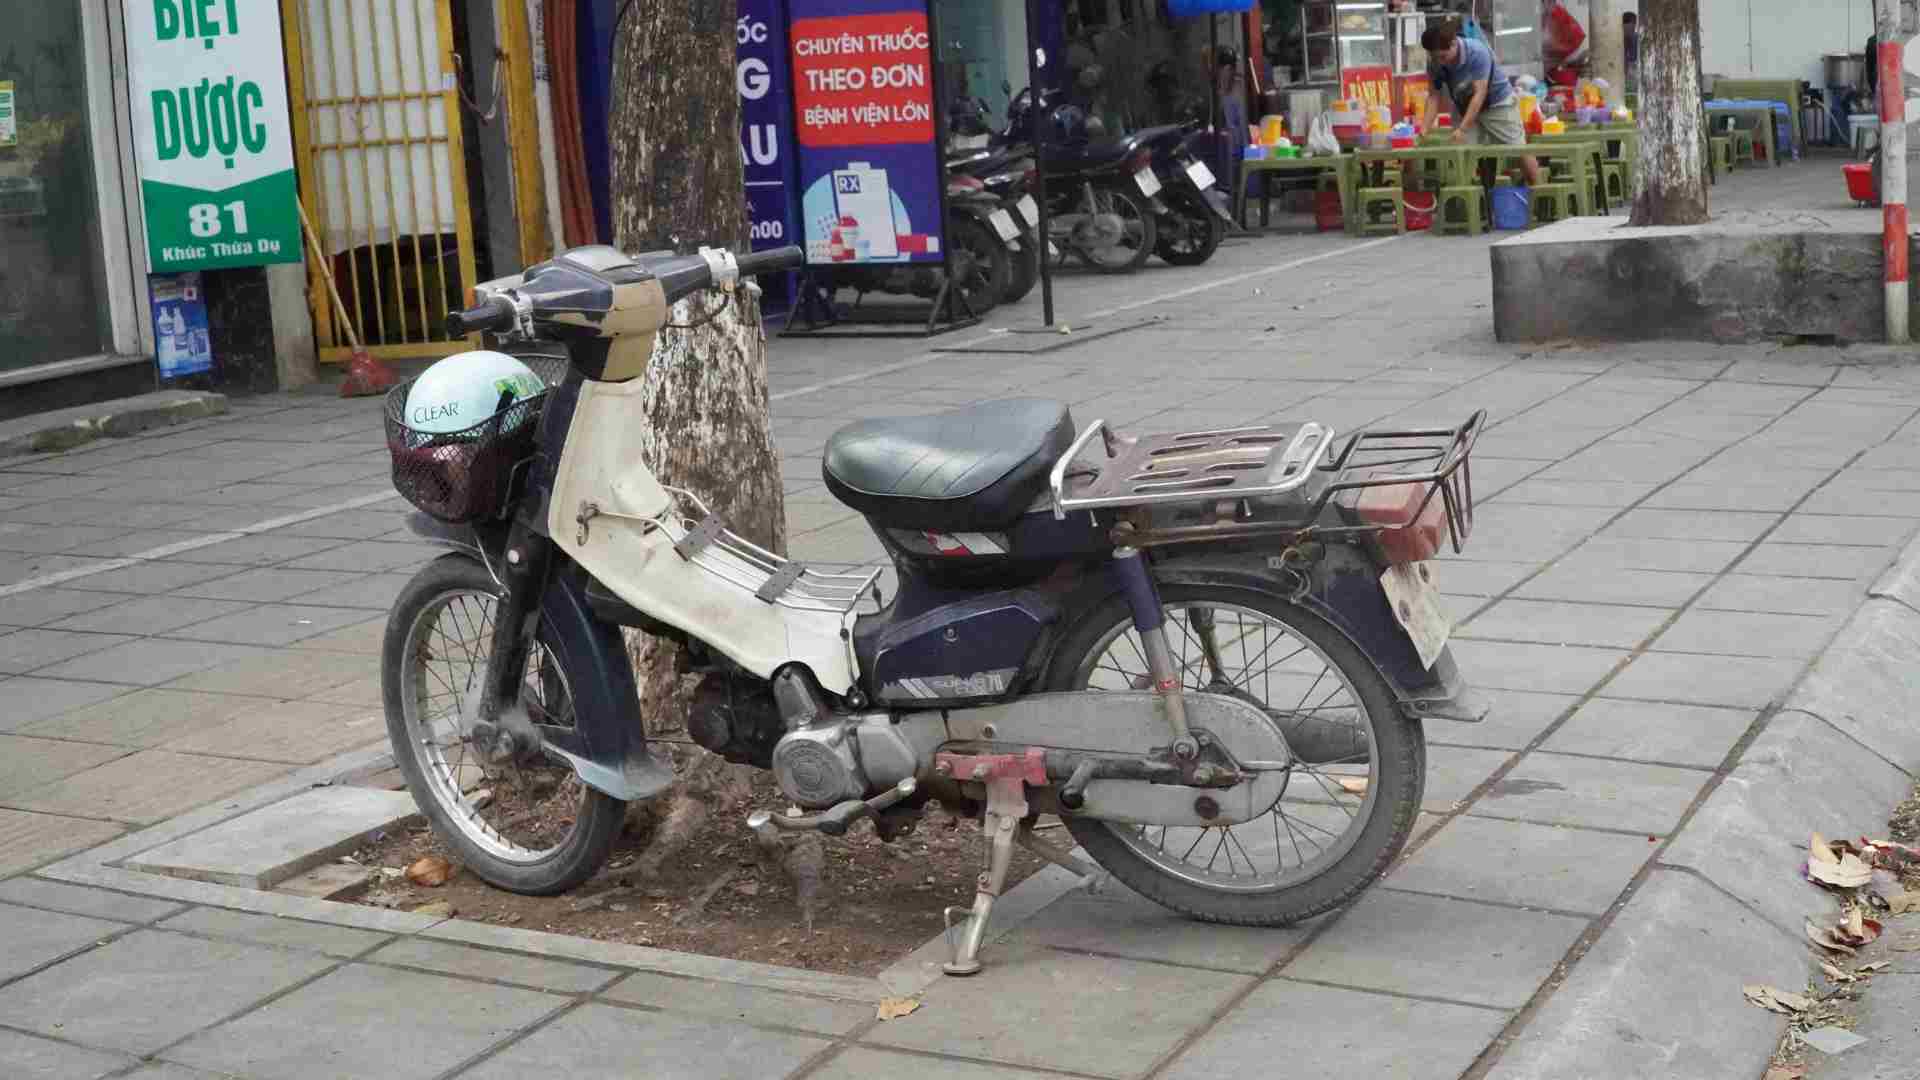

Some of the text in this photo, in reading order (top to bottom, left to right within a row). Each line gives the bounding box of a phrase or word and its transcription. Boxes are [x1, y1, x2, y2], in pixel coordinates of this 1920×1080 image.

[796, 24, 929, 55] CHUYÊN THUỐC
[805, 62, 925, 91] THEO ĐƠN
[152, 76, 266, 168] DƯỢC
[804, 99, 929, 130] BỆNH VIỆN LỚN
[840, 176, 859, 192] RX
[189, 200, 248, 238] 81
[162, 245, 206, 262] Khúc
[257, 238, 281, 254] Dụ
[414, 402, 459, 424] CLEAR
